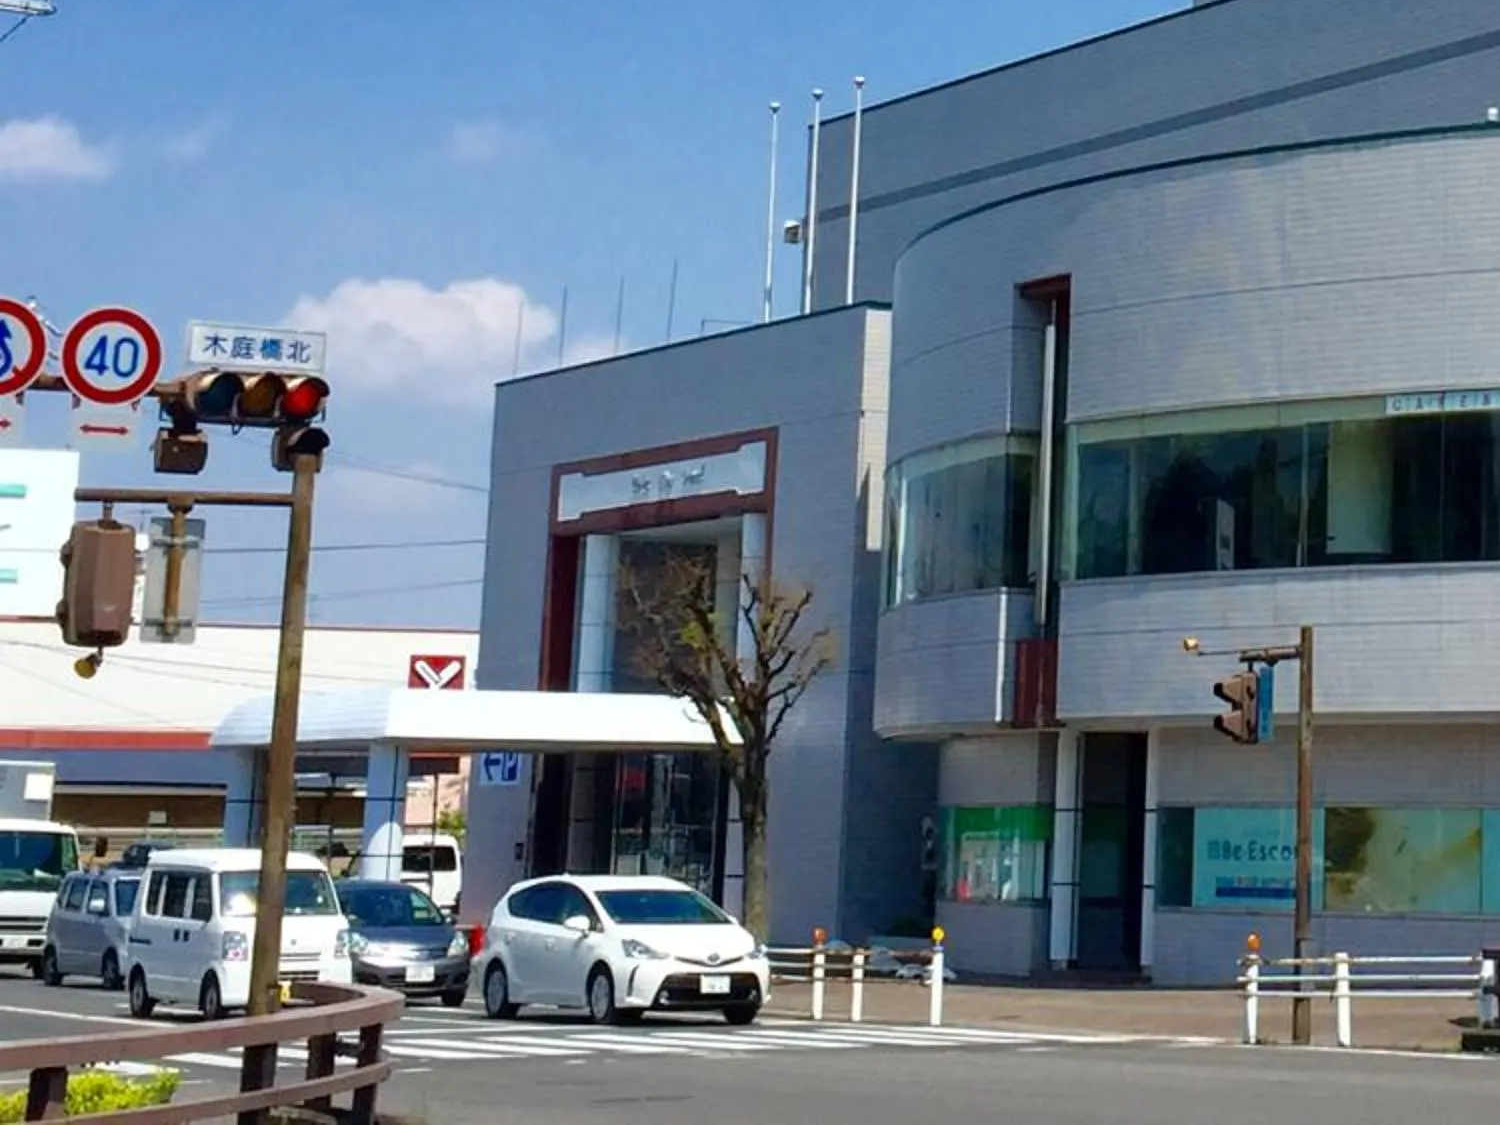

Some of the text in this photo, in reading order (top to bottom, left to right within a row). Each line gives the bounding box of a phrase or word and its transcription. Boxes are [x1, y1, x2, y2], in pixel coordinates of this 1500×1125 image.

[84, 334, 141, 379] 40
[203, 332, 312, 365] 木庭橋北
[1247, 839, 1299, 862] Esco
